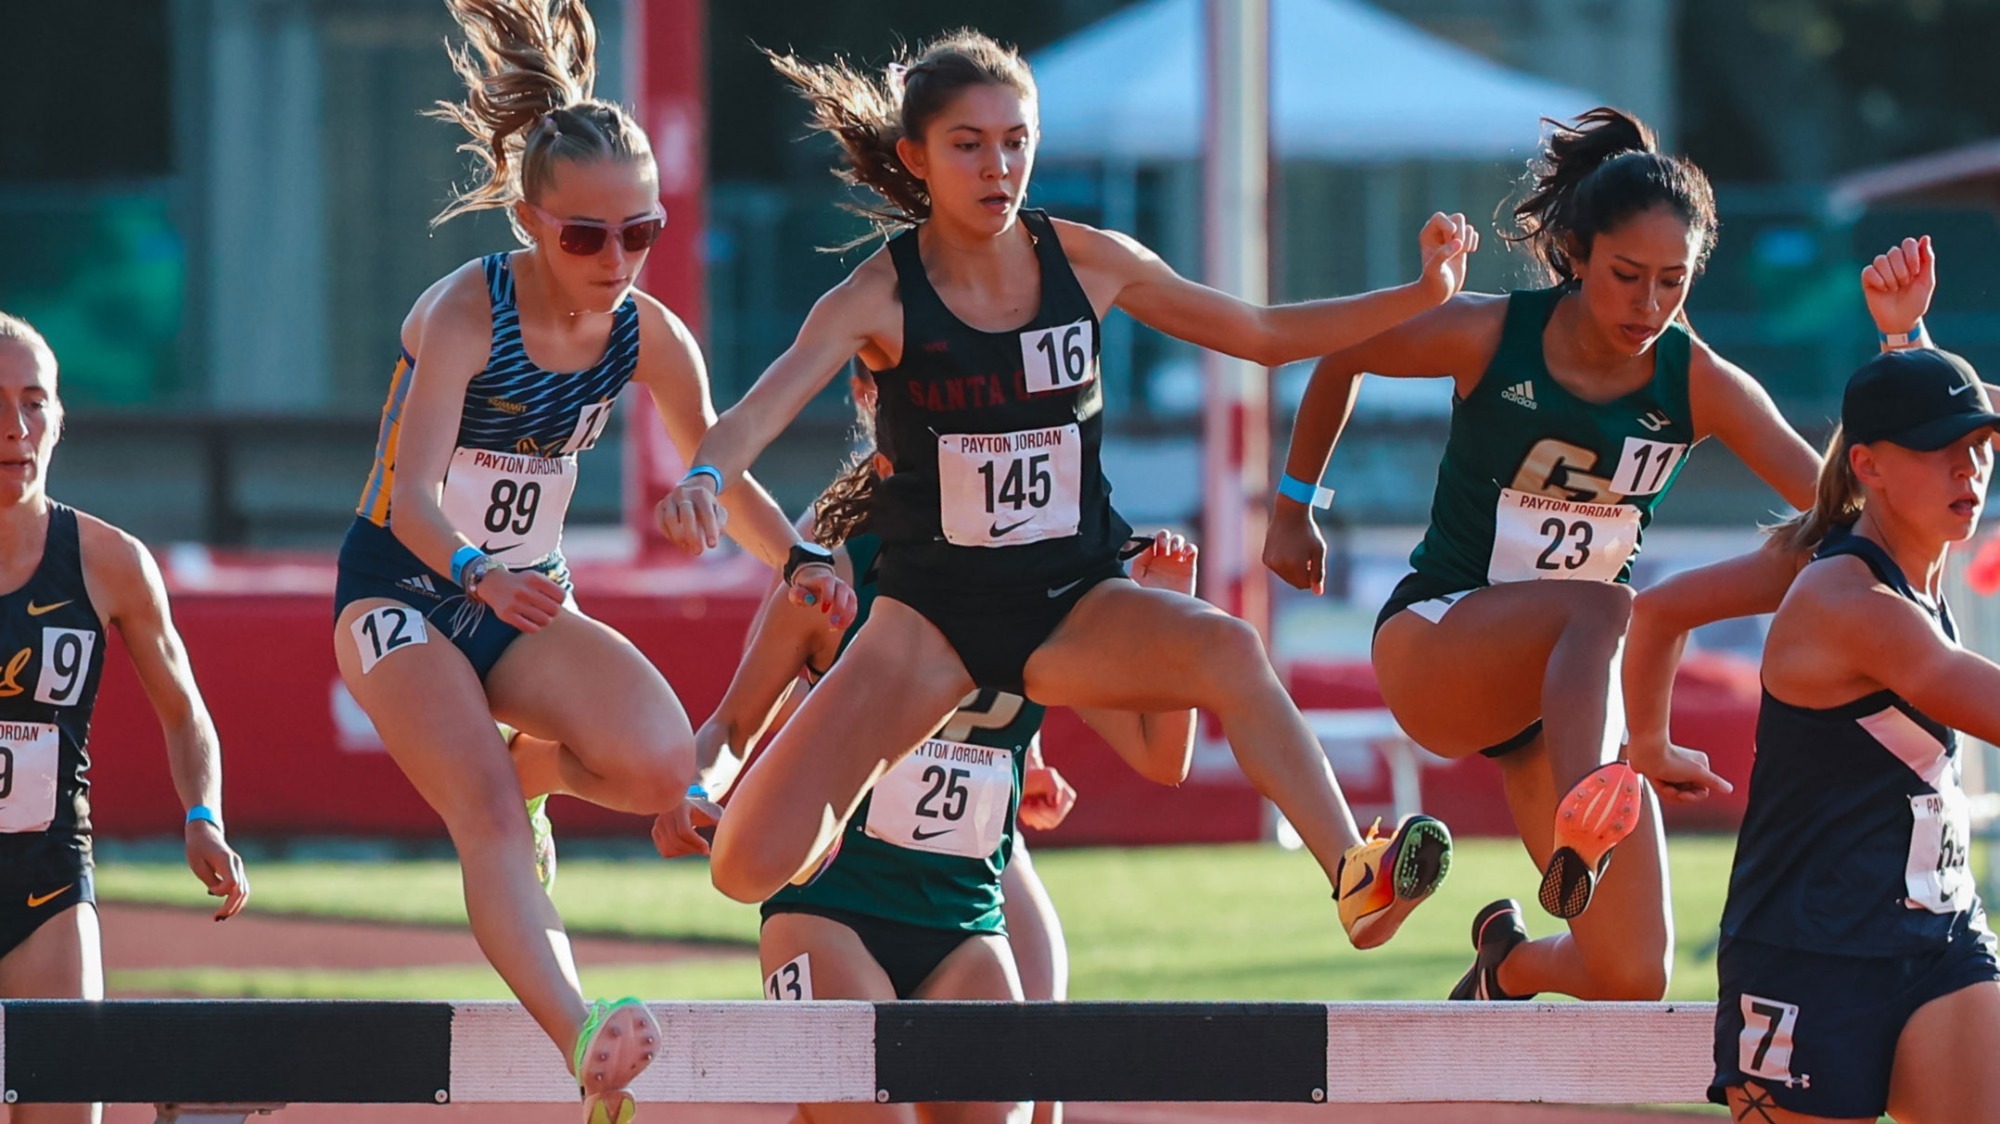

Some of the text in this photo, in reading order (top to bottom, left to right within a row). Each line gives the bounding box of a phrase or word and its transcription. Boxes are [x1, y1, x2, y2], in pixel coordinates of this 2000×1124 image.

[1036, 326, 1085, 386] 16
[907, 374, 1006, 412] SANTA
[1501, 390, 1538, 410] adidas
[473, 451, 564, 475] PAYTON JORDAN
[961, 429, 1062, 454] PAYTON JORDAN
[977, 453, 1051, 514] 145
[1630, 443, 1674, 492] 11
[484, 479, 541, 535] 89
[1519, 495, 1623, 519] PAYTON JORDAN
[1536, 517, 1594, 570] 23
[362, 608, 412, 659] 12
[48, 633, 82, 701] 9
[950, 746, 995, 766] JORDAN
[915, 765, 971, 821] 25
[770, 961, 802, 1000] 13
[1750, 1001, 1785, 1072] 7
